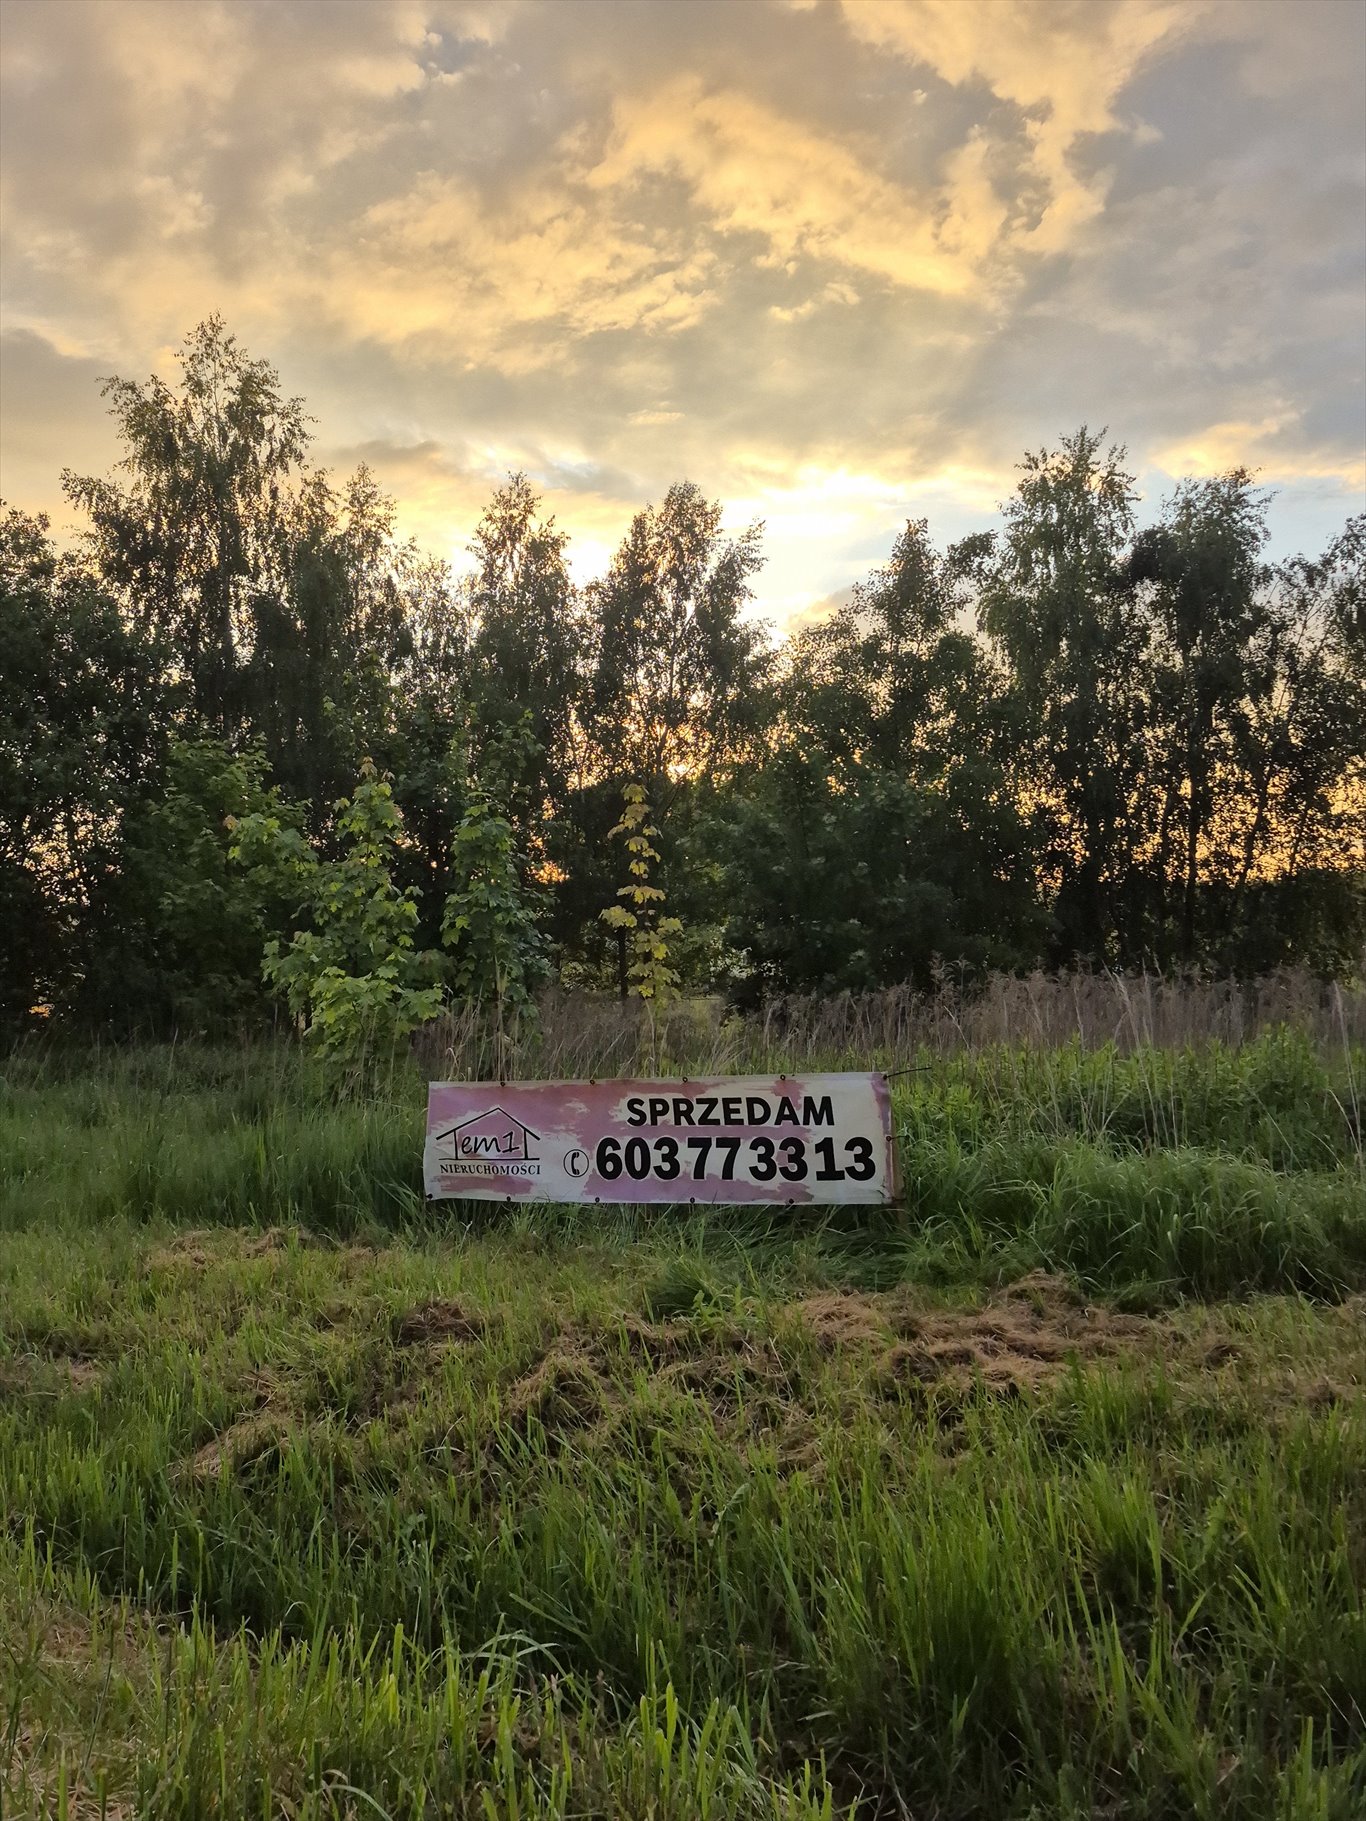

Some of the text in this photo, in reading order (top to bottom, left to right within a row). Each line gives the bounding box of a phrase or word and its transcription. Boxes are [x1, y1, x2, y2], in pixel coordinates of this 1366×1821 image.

[626, 1096, 835, 1126] SPRZEDAM
[460, 1131, 520, 1154] em1
[439, 1162, 541, 1176] NIERUCHOMOŚCI
